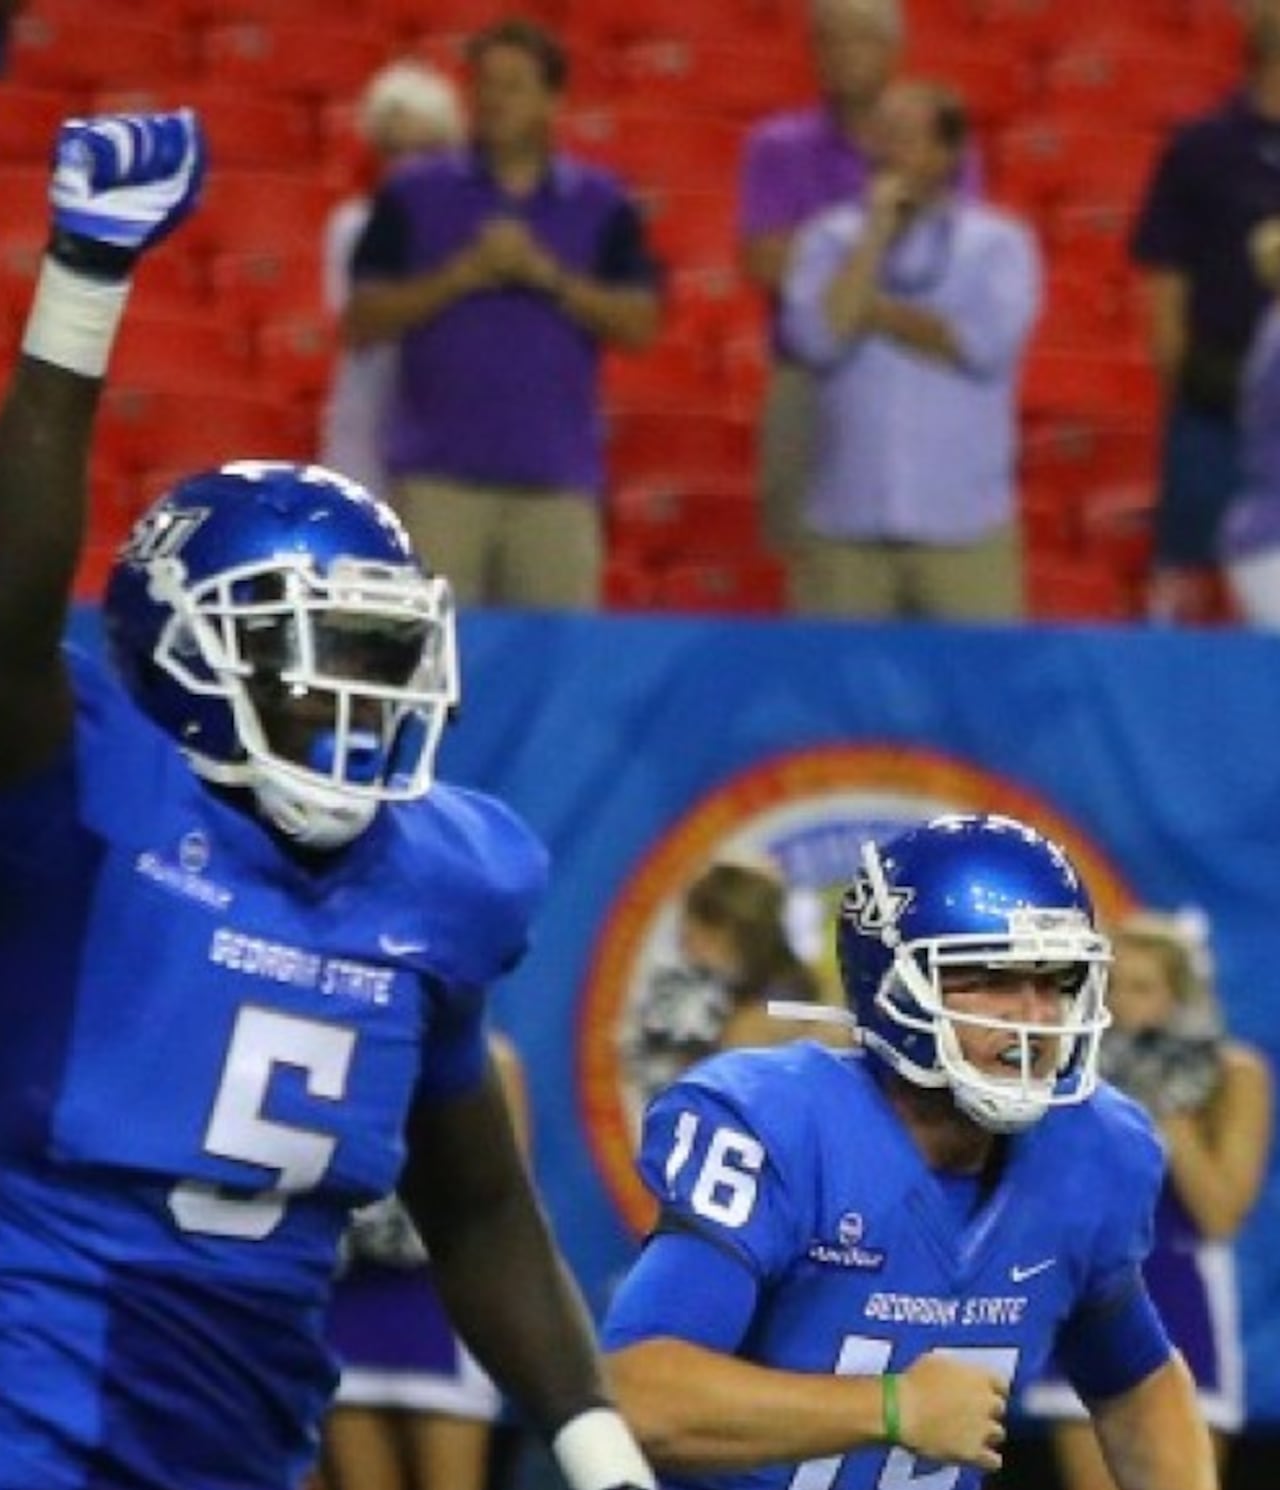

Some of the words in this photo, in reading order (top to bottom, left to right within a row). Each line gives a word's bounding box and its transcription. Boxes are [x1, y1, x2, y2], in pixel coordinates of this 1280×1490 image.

[166, 1004, 357, 1242] 5
[665, 1110, 766, 1229] 16
[961, 1296, 1029, 1326] STATE
